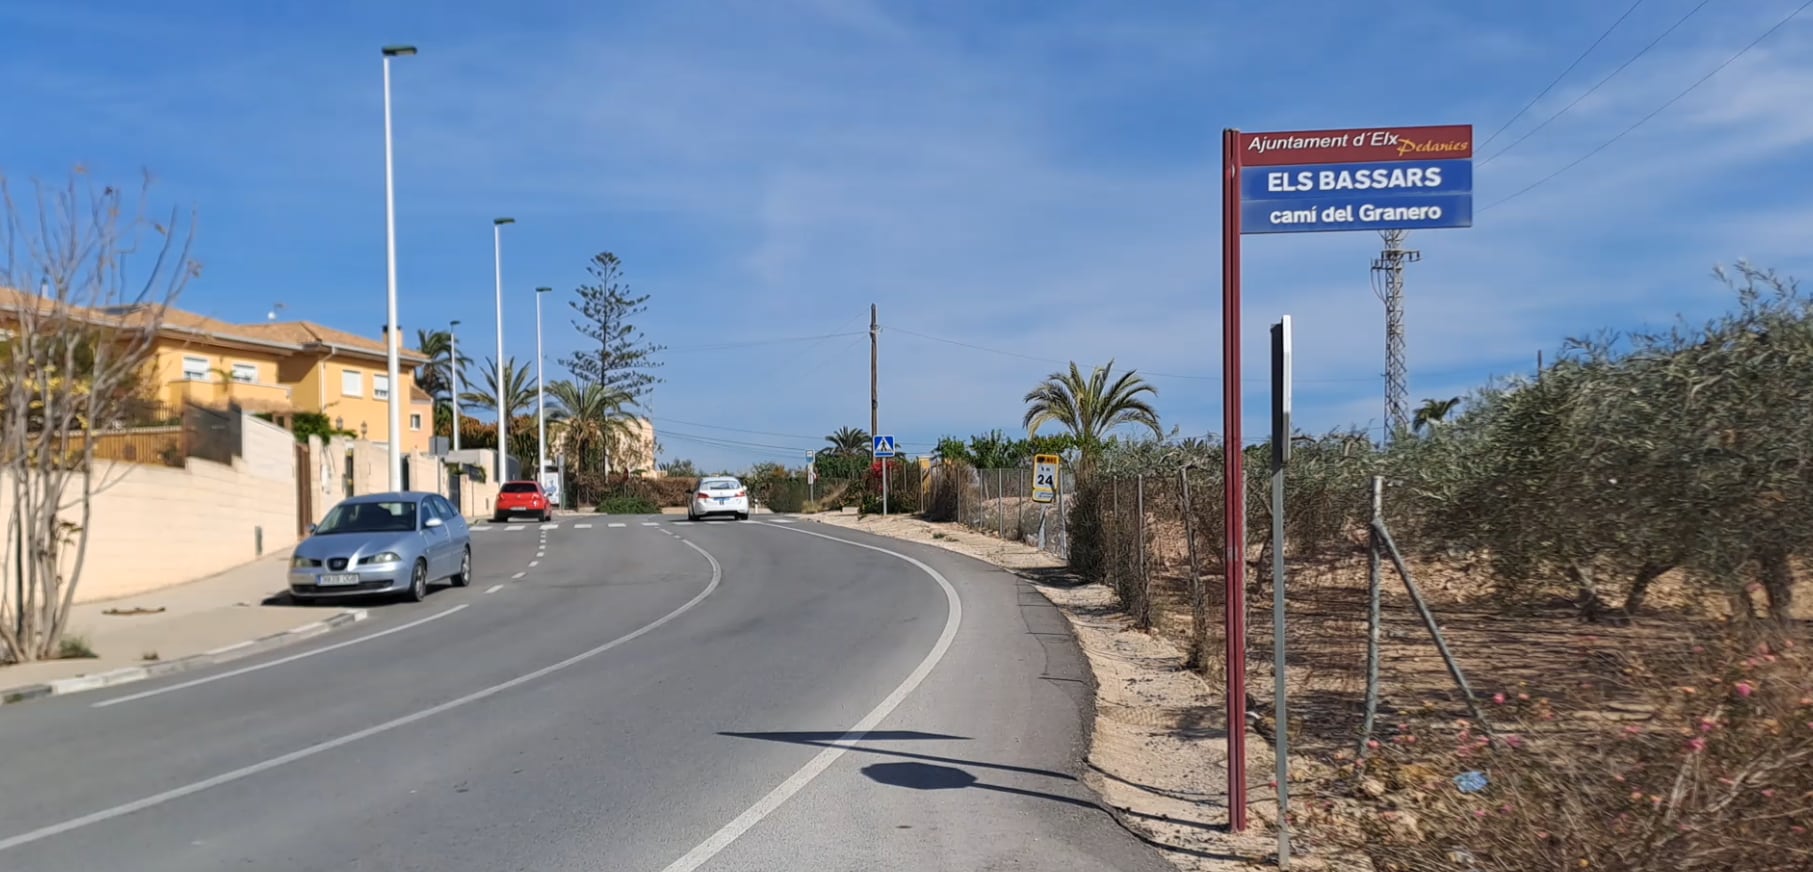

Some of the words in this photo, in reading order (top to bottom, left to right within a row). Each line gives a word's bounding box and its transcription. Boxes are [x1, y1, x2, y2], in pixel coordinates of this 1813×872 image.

[1248, 134, 1348, 154] Ajuntament
[1268, 171, 1313, 192] ELS
[1319, 167, 1442, 190] BASSARS
[1269, 205, 1317, 224] camí
[1321, 205, 1354, 222] del
[1359, 203, 1442, 222] Granero
[1037, 474, 1053, 486] 24
